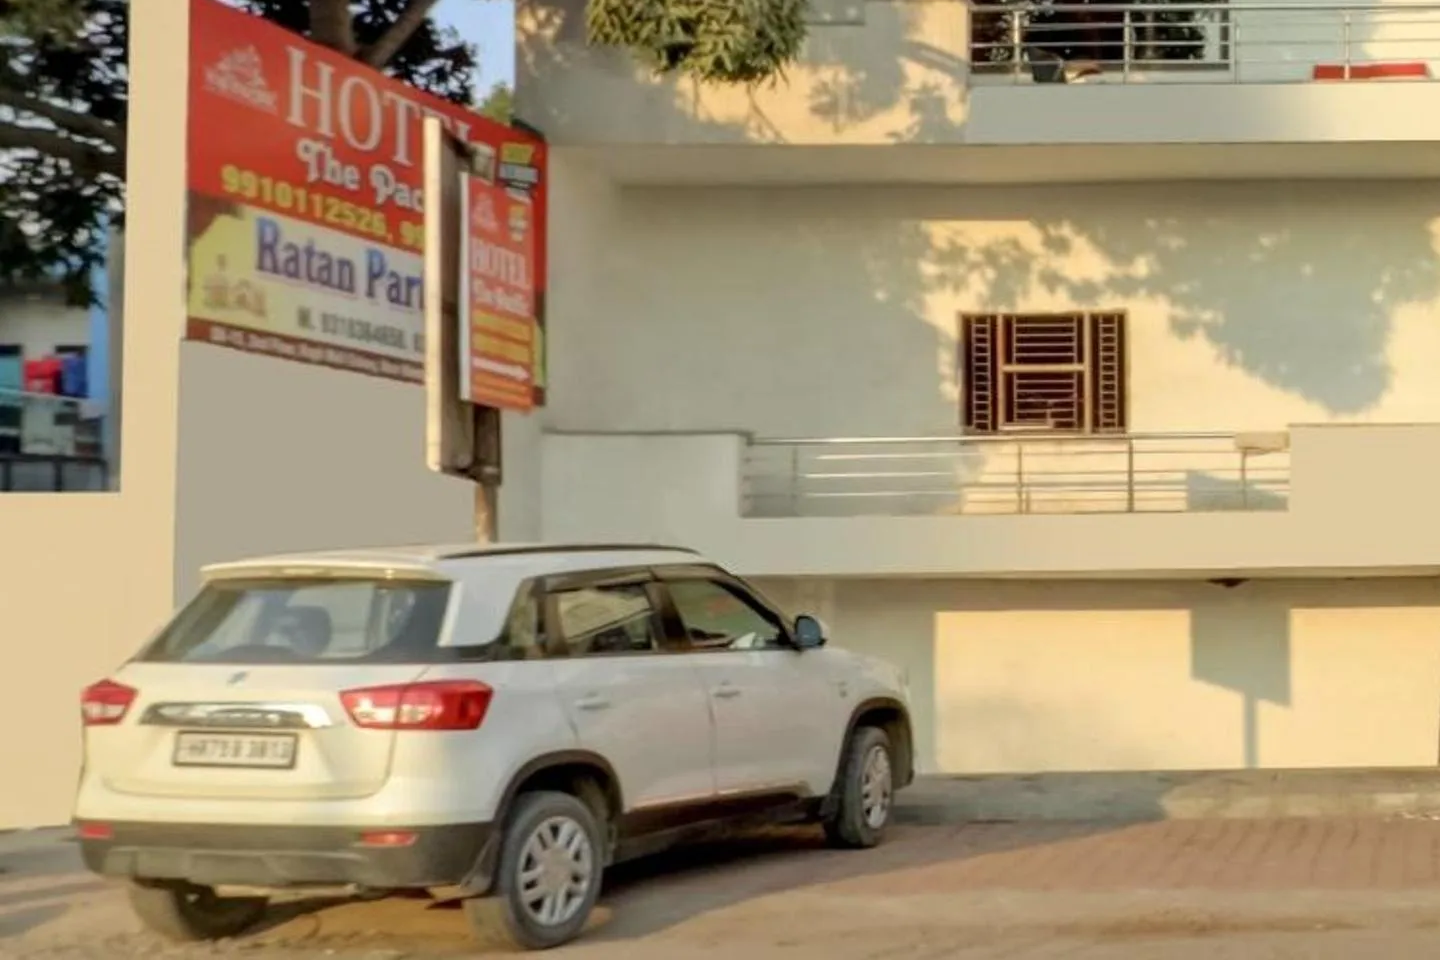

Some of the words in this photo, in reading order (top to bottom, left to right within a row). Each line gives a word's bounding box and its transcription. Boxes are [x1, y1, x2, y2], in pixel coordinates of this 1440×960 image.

[286, 46, 470, 168] HOT
[221, 163, 393, 242] 9910112526,
[296, 137, 360, 190] The
[369, 164, 425, 213] Pac
[256, 215, 355, 295] Ratan
